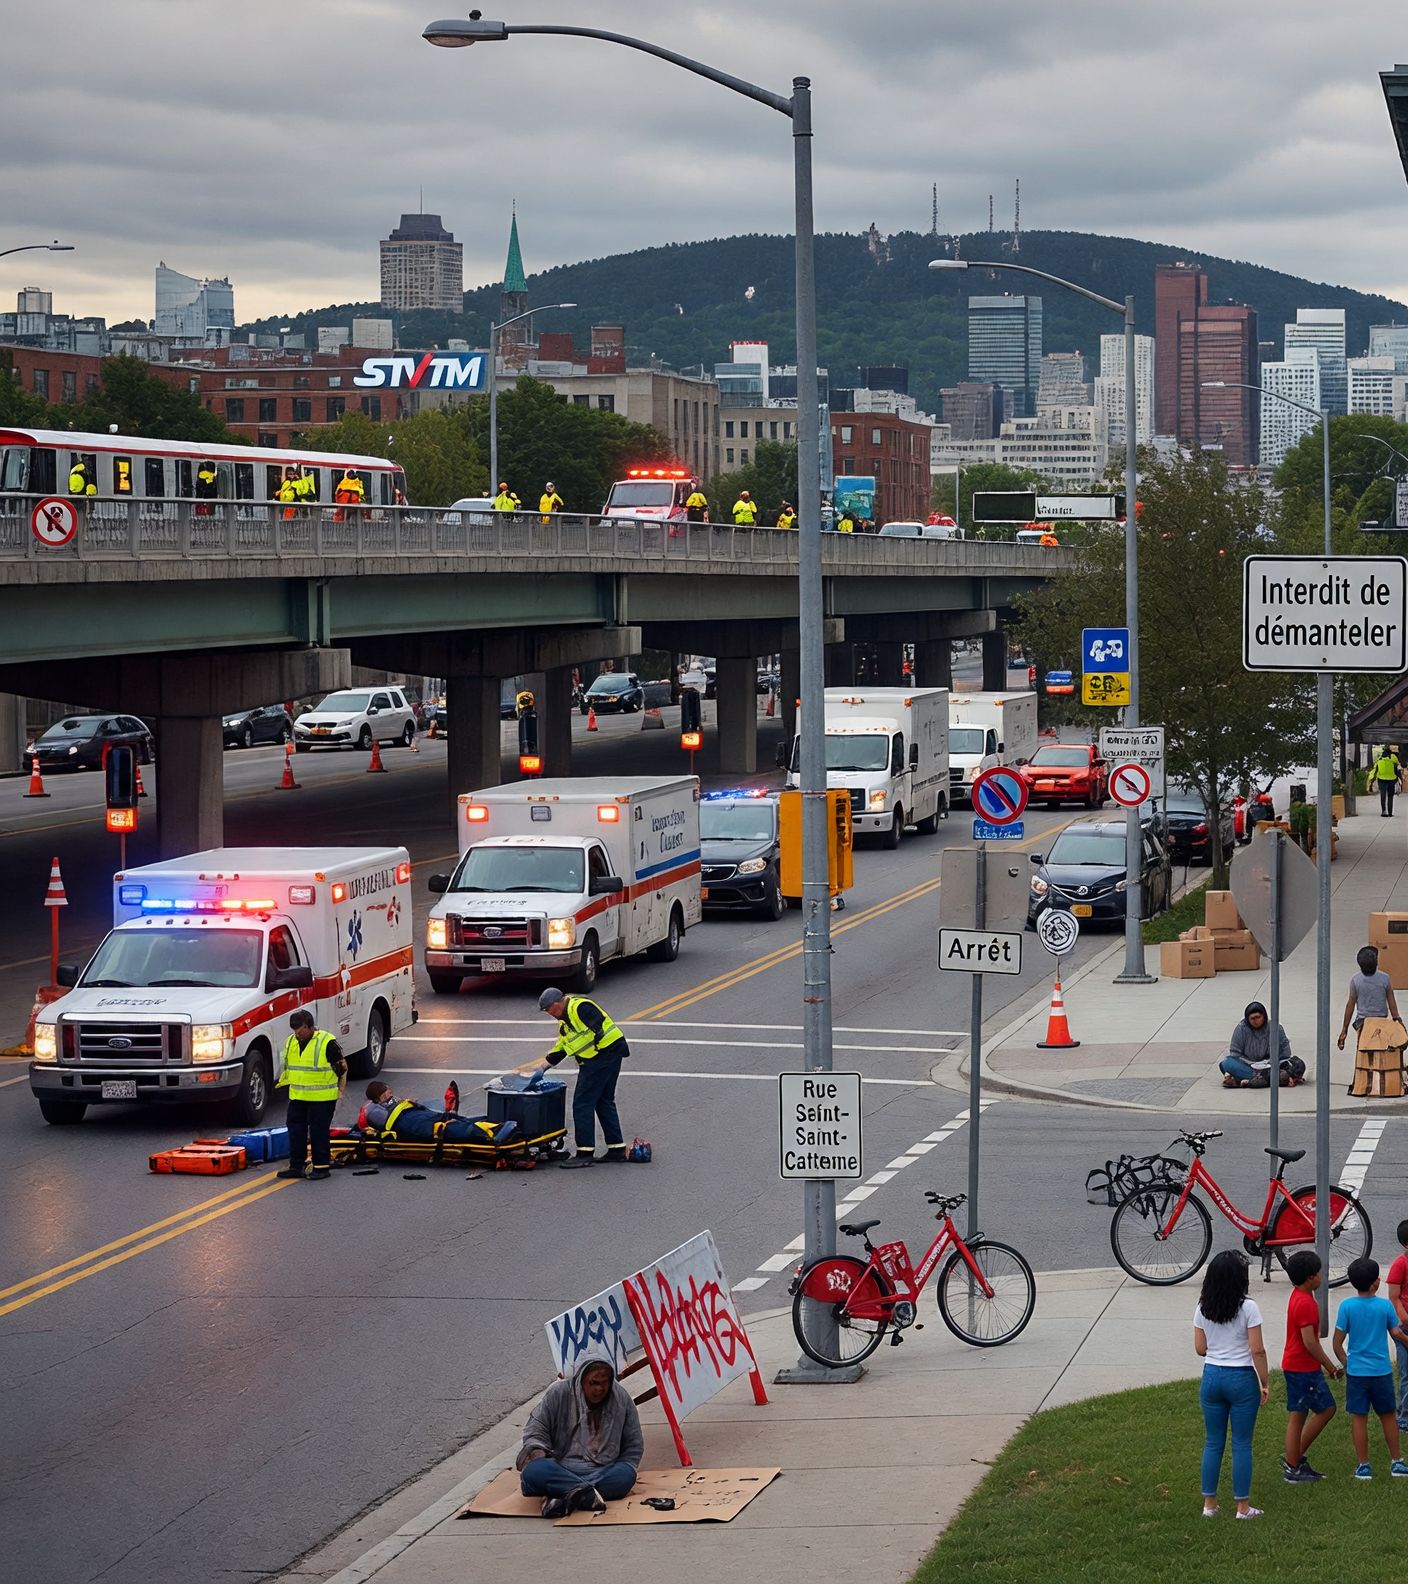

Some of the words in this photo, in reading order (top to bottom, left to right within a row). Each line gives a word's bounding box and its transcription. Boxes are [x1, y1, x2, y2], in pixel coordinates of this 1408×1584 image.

[1262, 575, 1350, 605] Interdit
[1361, 575, 1390, 605] de
[1255, 615, 1396, 646] démanteler
[947, 937, 1012, 962] Arrêt
[803, 1079, 837, 1098] Rue
[796, 1126, 847, 1146] Saint-
